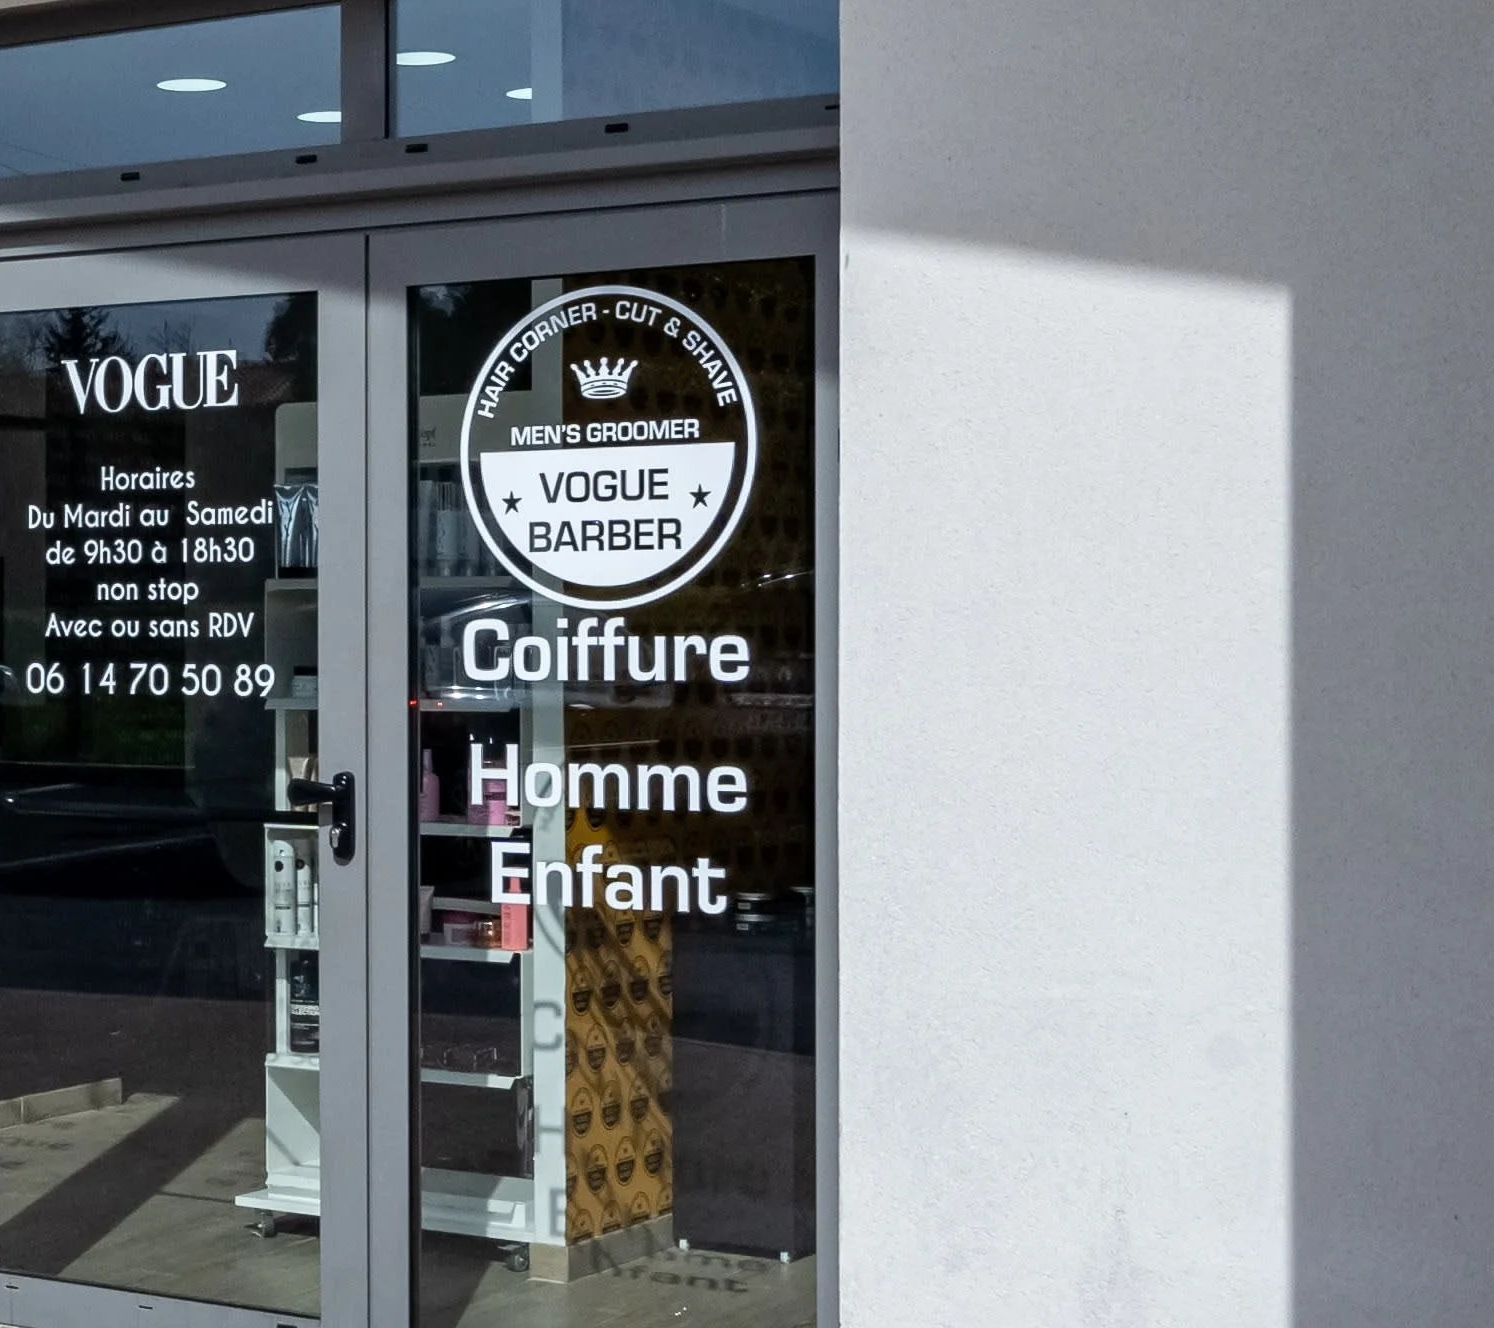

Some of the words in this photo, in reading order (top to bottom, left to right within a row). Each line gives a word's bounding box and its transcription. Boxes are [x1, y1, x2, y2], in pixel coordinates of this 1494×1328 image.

[477, 361, 515, 418] HAIR
[509, 302, 597, 362] CORNER
[615, 300, 662, 326] CUT
[663, 317, 681, 338] &
[681, 330, 738, 407] SHAVE
[61, 349, 239, 415] VOGUE
[510, 423, 582, 447] MEN'S
[586, 418, 700, 444] GROOMER
[100, 465, 196, 491] Horaires
[539, 468, 669, 504] VOGUE
[28, 504, 55, 530] Du
[64, 502, 131, 529] Mardi
[140, 508, 169, 527] au
[186, 498, 274, 526] Samedi
[46, 540, 75, 565] de
[83, 538, 143, 565] 9h30
[155, 540, 167, 564] à
[181, 536, 255, 563] 18h30
[528, 518, 683, 553] BARBER
[97, 582, 139, 601] non
[147, 577, 200, 606] stop
[44, 612, 103, 638] Avec
[110, 618, 140, 638] ou
[148, 619, 200, 638] sans
[208, 611, 255, 638] RDV
[463, 616, 750, 682] Coiffure
[26, 662, 65, 695] 06
[82, 662, 117, 695] 14
[129, 662, 170, 696] 70
[181, 663, 222, 697] 50
[233, 663, 276, 697] 89
[471, 743, 748, 813] Homme
[491, 841, 727, 914] Enfant
